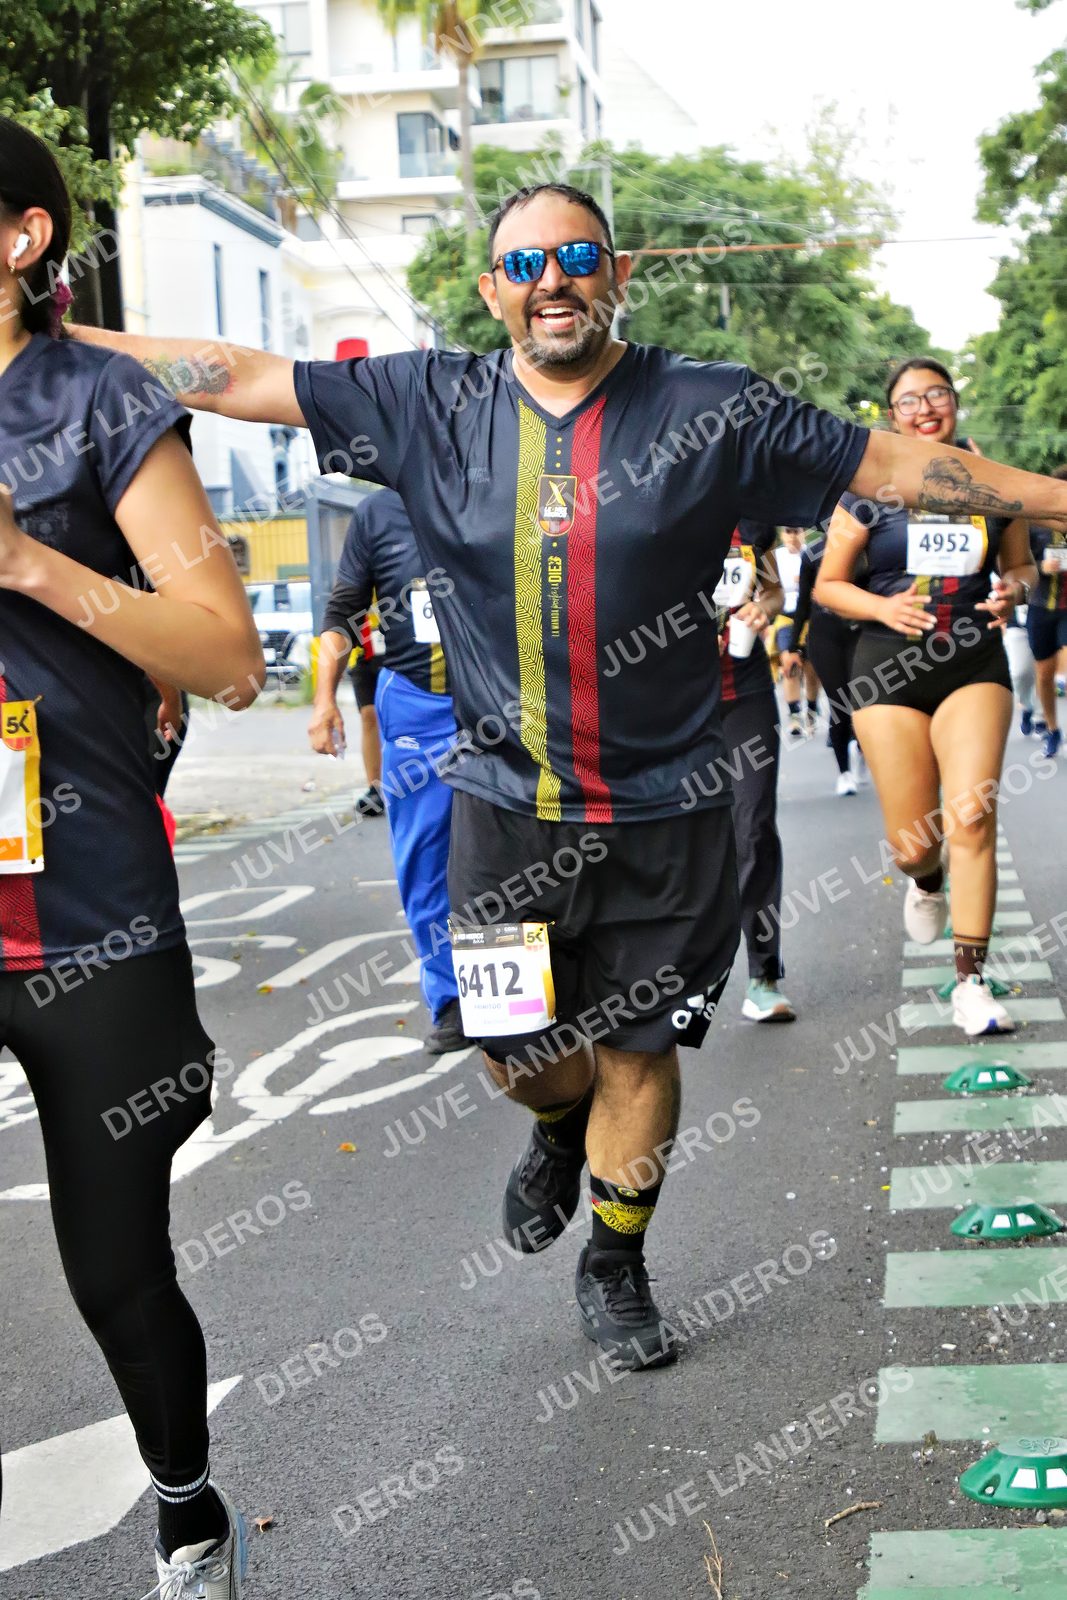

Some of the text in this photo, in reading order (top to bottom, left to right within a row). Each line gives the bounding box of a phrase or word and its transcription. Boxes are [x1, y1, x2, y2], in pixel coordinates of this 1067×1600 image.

[919, 532, 970, 552] 4952
[6, 713, 30, 734] 5K
[526, 931, 543, 943] 5K
[458, 961, 524, 998] 6412
